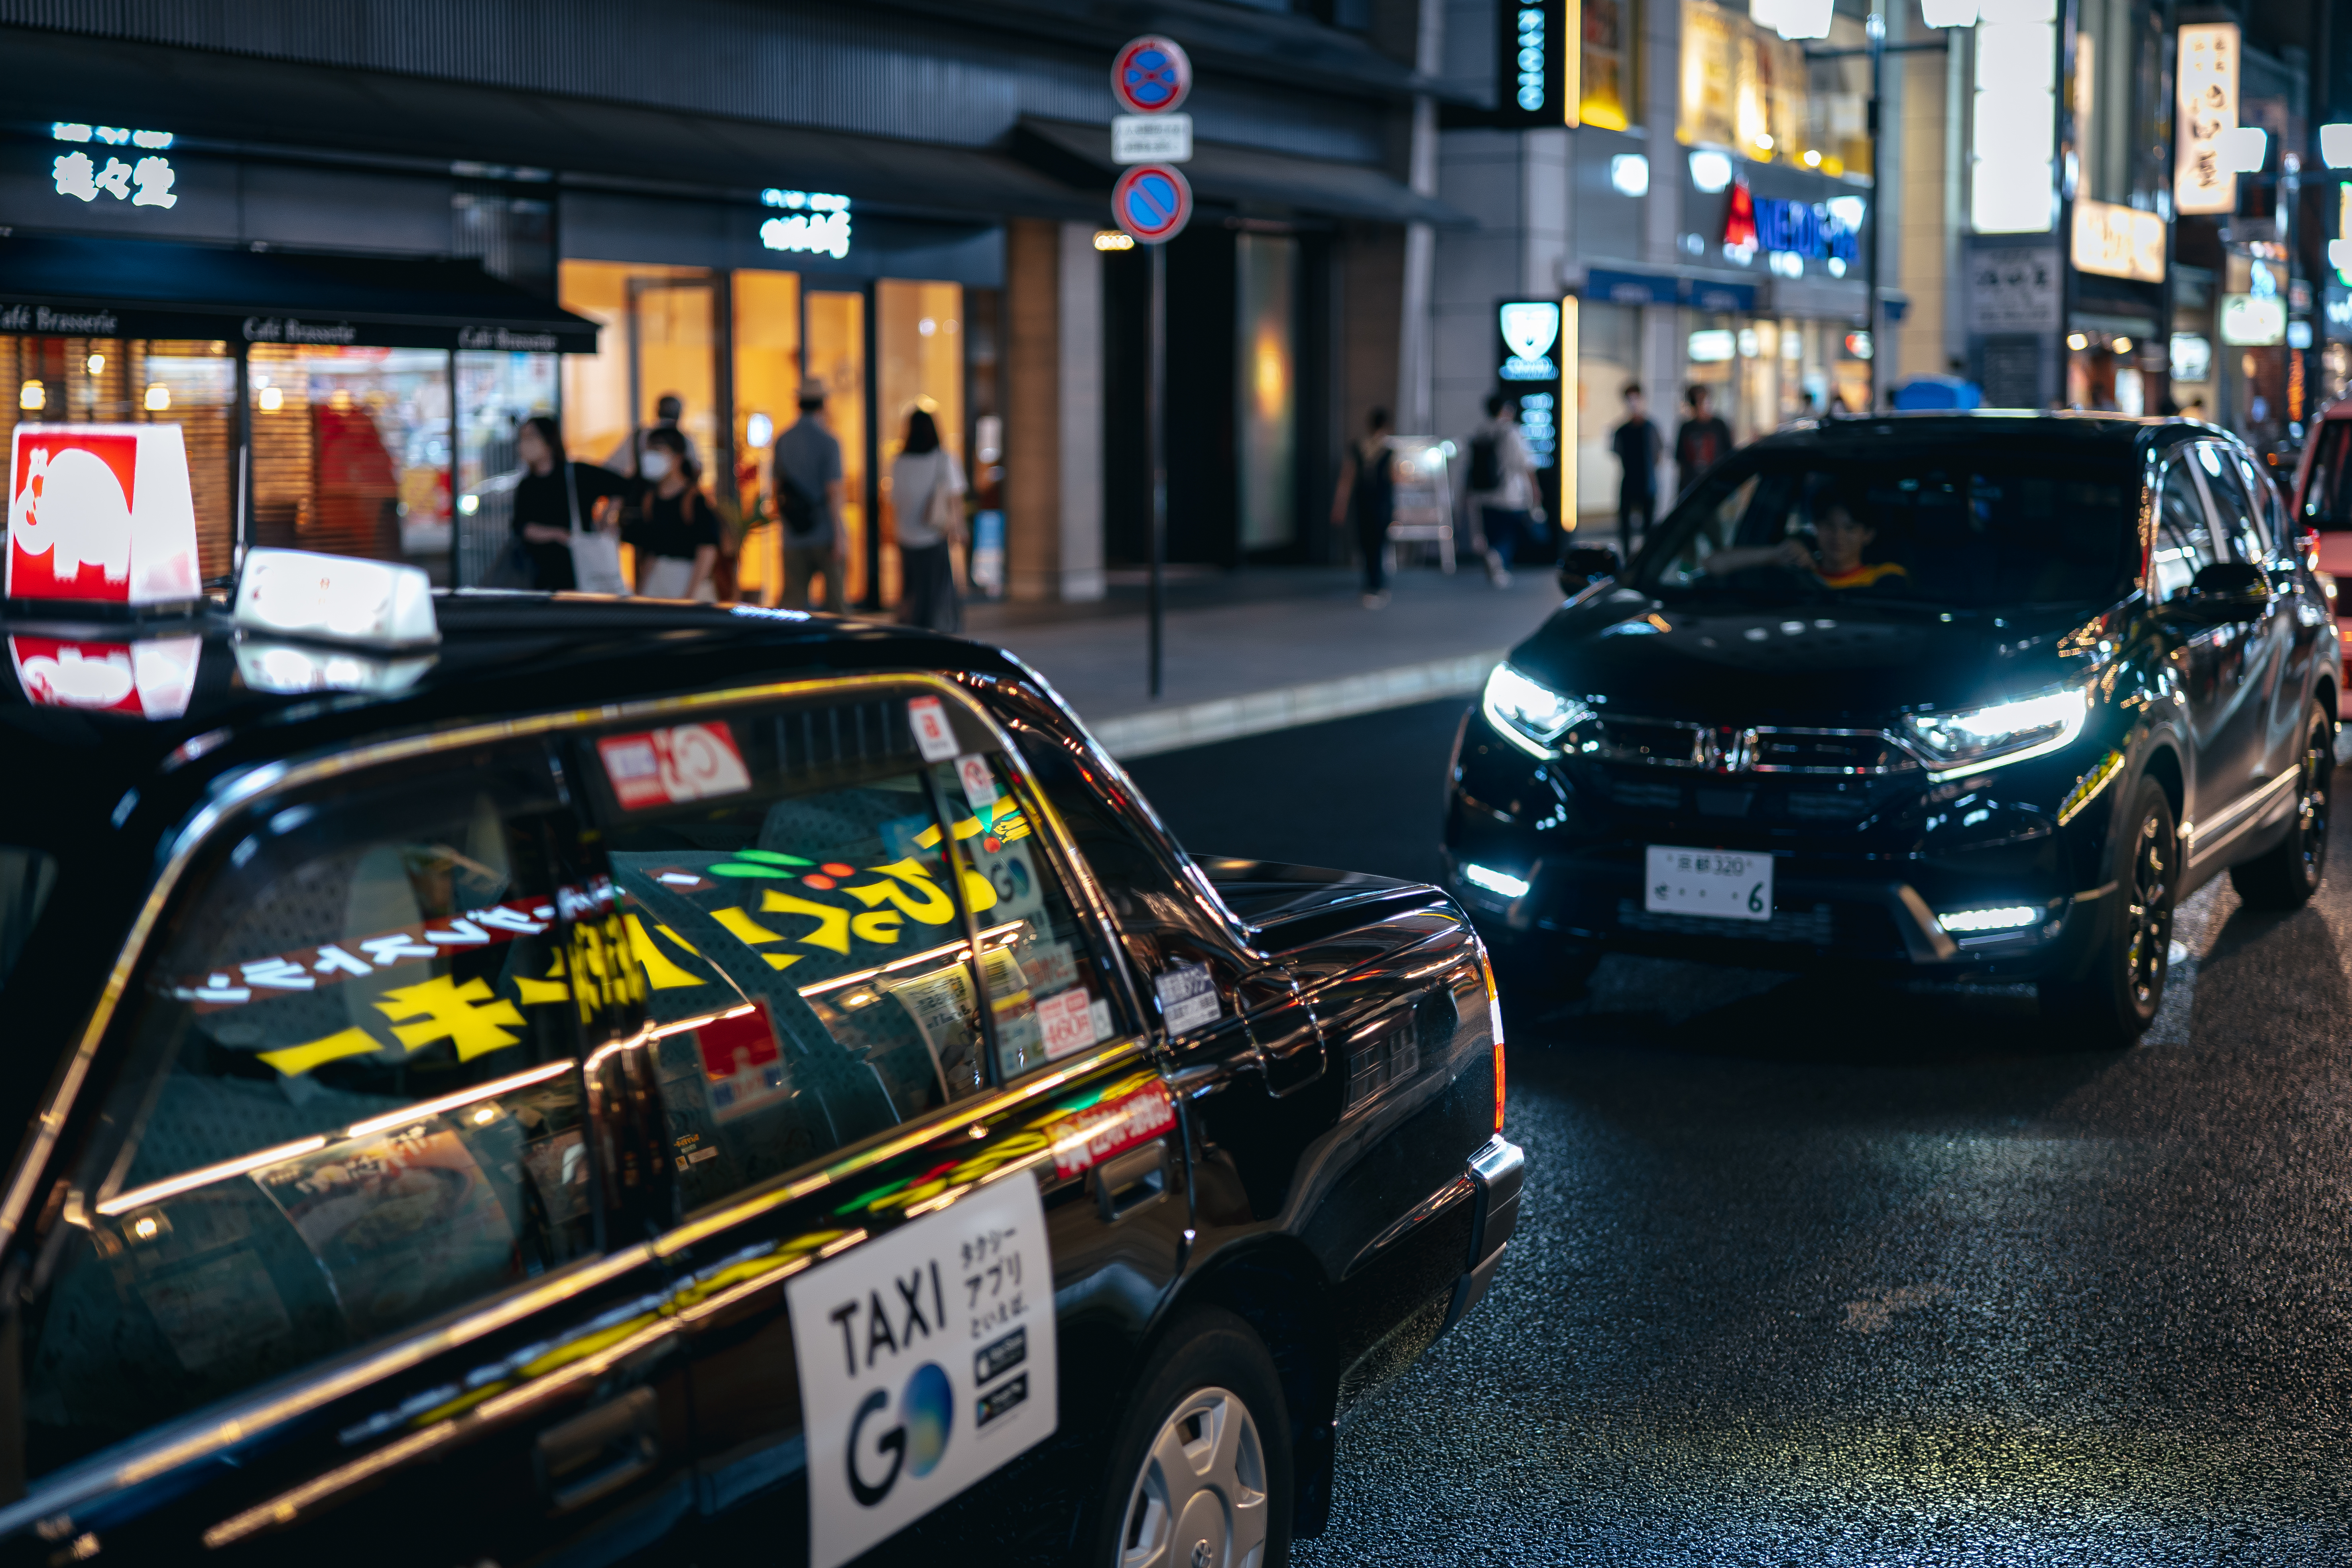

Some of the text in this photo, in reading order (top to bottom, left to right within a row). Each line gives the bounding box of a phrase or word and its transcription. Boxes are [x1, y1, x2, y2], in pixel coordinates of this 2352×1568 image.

[0, 304, 118, 334] afé Brasserie
[960, 1227, 1017, 1270] タクシー
[965, 1250, 1022, 1309] アプリ
[829, 1259, 947, 1378] TAXI
[844, 1360, 954, 1507] GO
